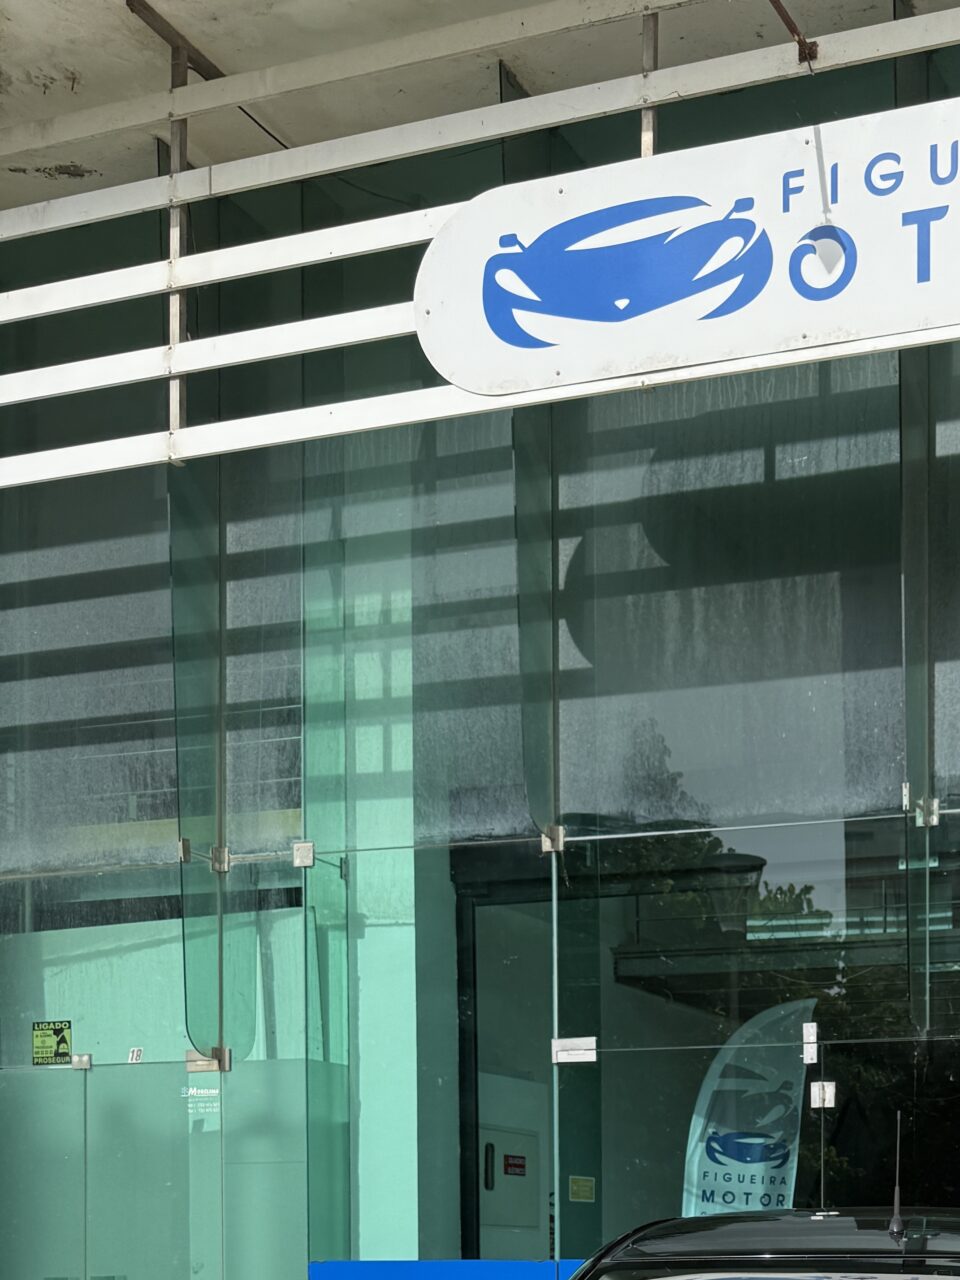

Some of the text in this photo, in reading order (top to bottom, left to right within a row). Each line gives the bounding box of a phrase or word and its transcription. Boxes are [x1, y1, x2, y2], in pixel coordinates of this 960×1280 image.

[34, 1022, 69, 1030] LIGADO
[34, 1056, 71, 1064] PROSEGUR
[130, 1048, 142, 1062] 18
[702, 1171, 787, 1186] FIGUEIRA
[701, 1189, 786, 1207] MOTOR
